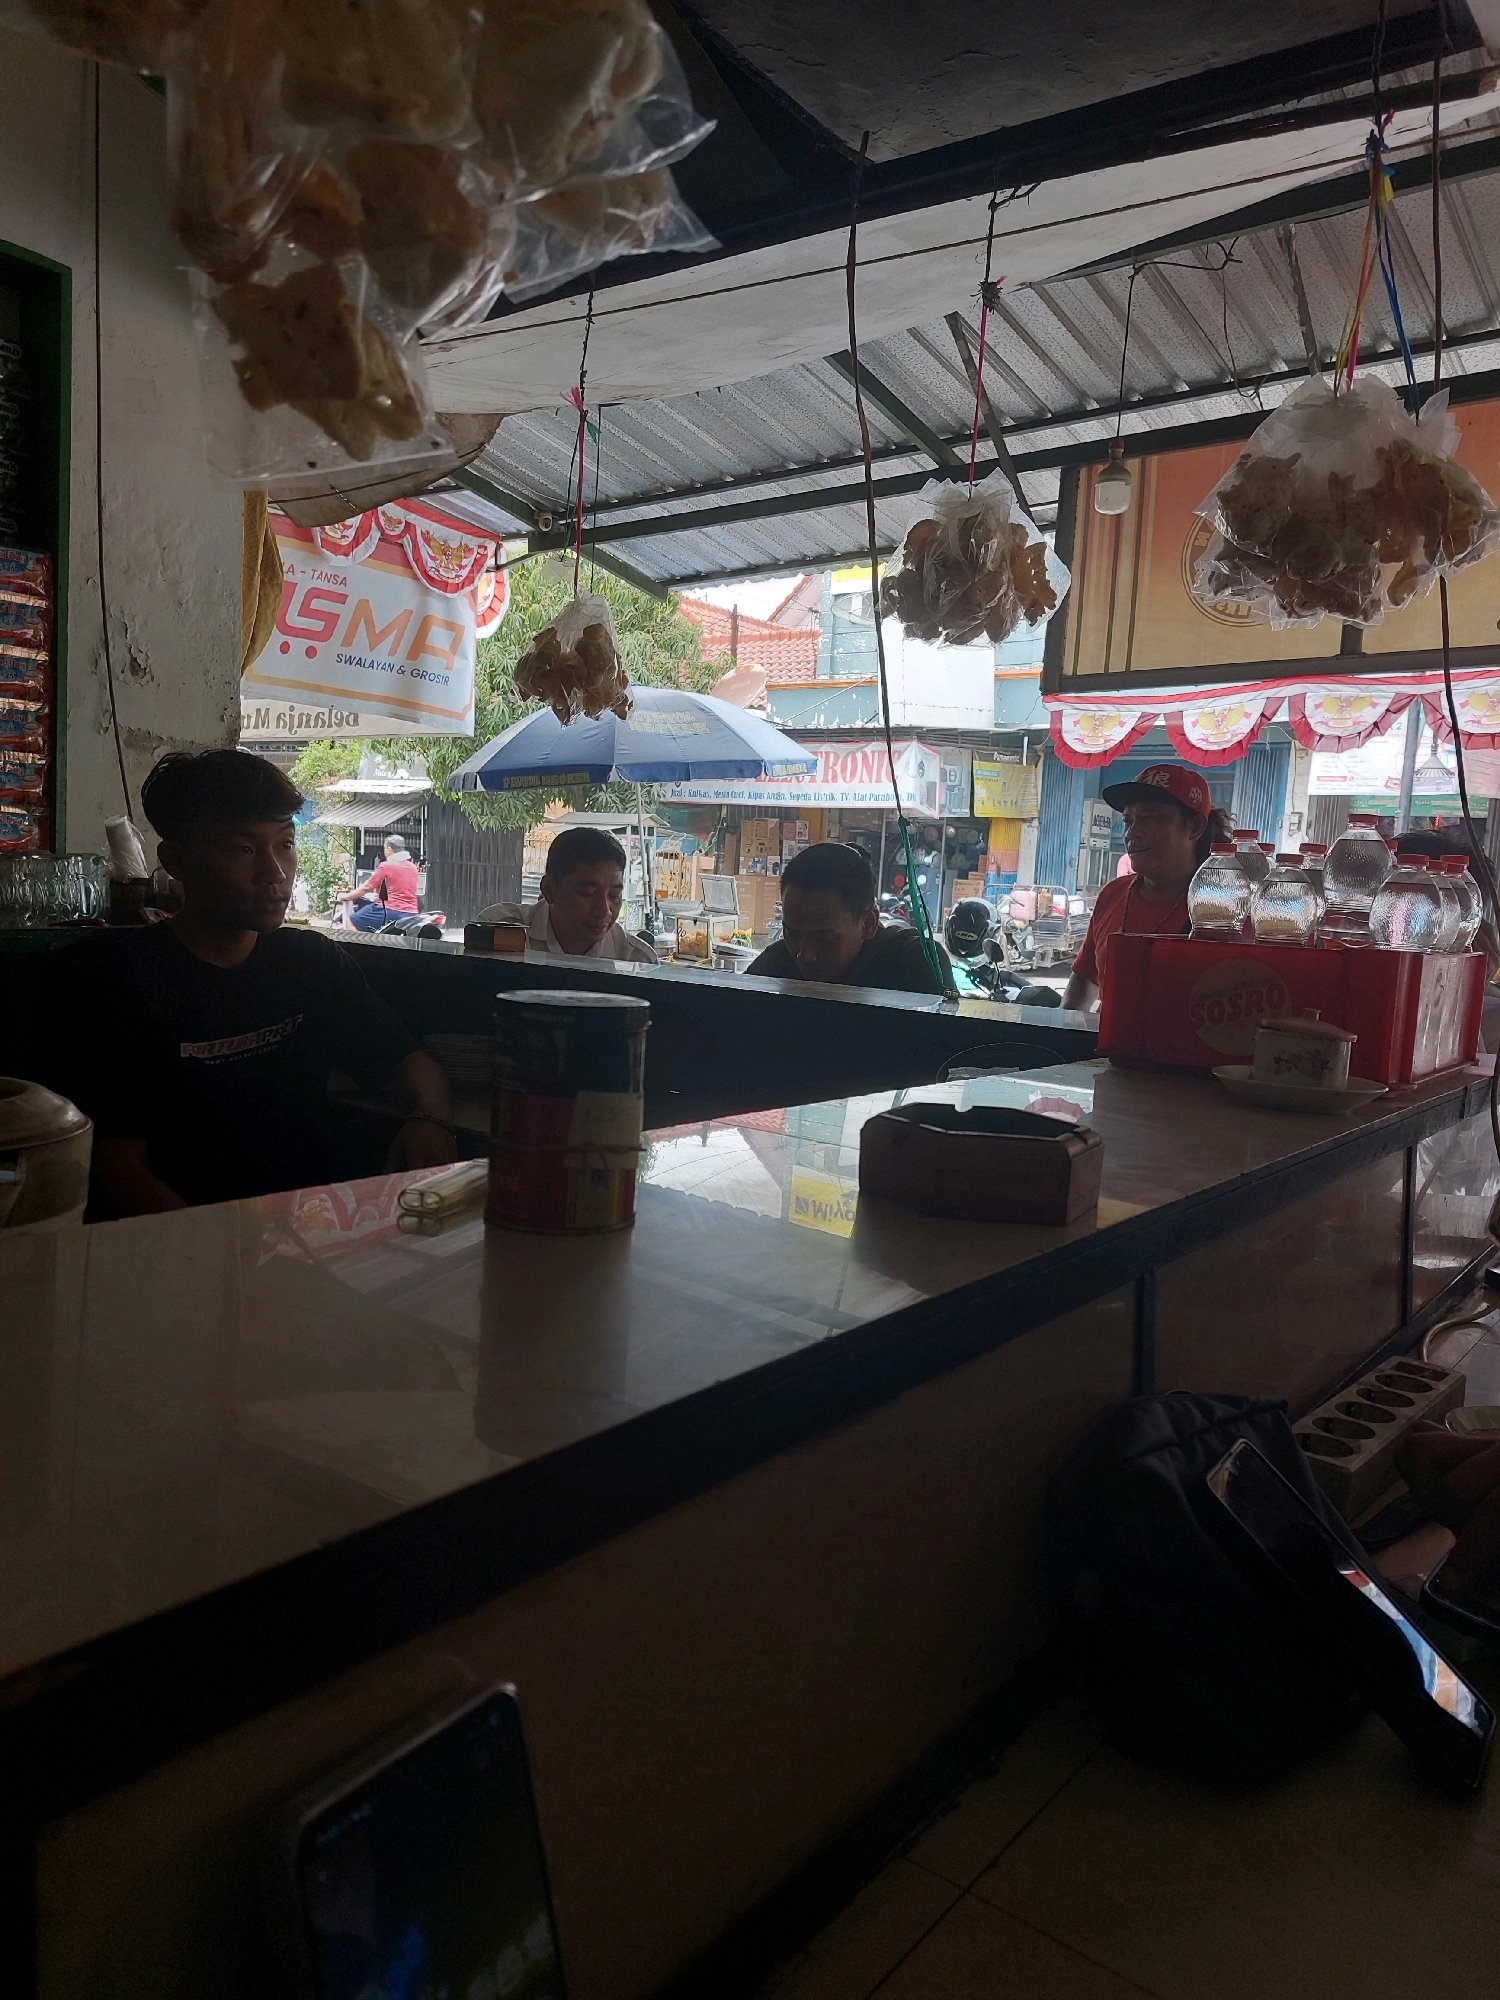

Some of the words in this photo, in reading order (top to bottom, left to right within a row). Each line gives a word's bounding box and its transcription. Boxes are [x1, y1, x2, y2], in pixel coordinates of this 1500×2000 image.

[310, 568, 347, 587] TANSA
[336, 653, 395, 673] SWALAYAN
[396, 665, 406, 676] &
[410, 668, 450, 686] GROSIR
[713, 789, 730, 799] Mesin
[747, 790, 765, 801] Kipas
[789, 791, 811, 802] Sepeda
[853, 792, 868, 802] Alat
[1189, 982, 1286, 1029] SOSRO
